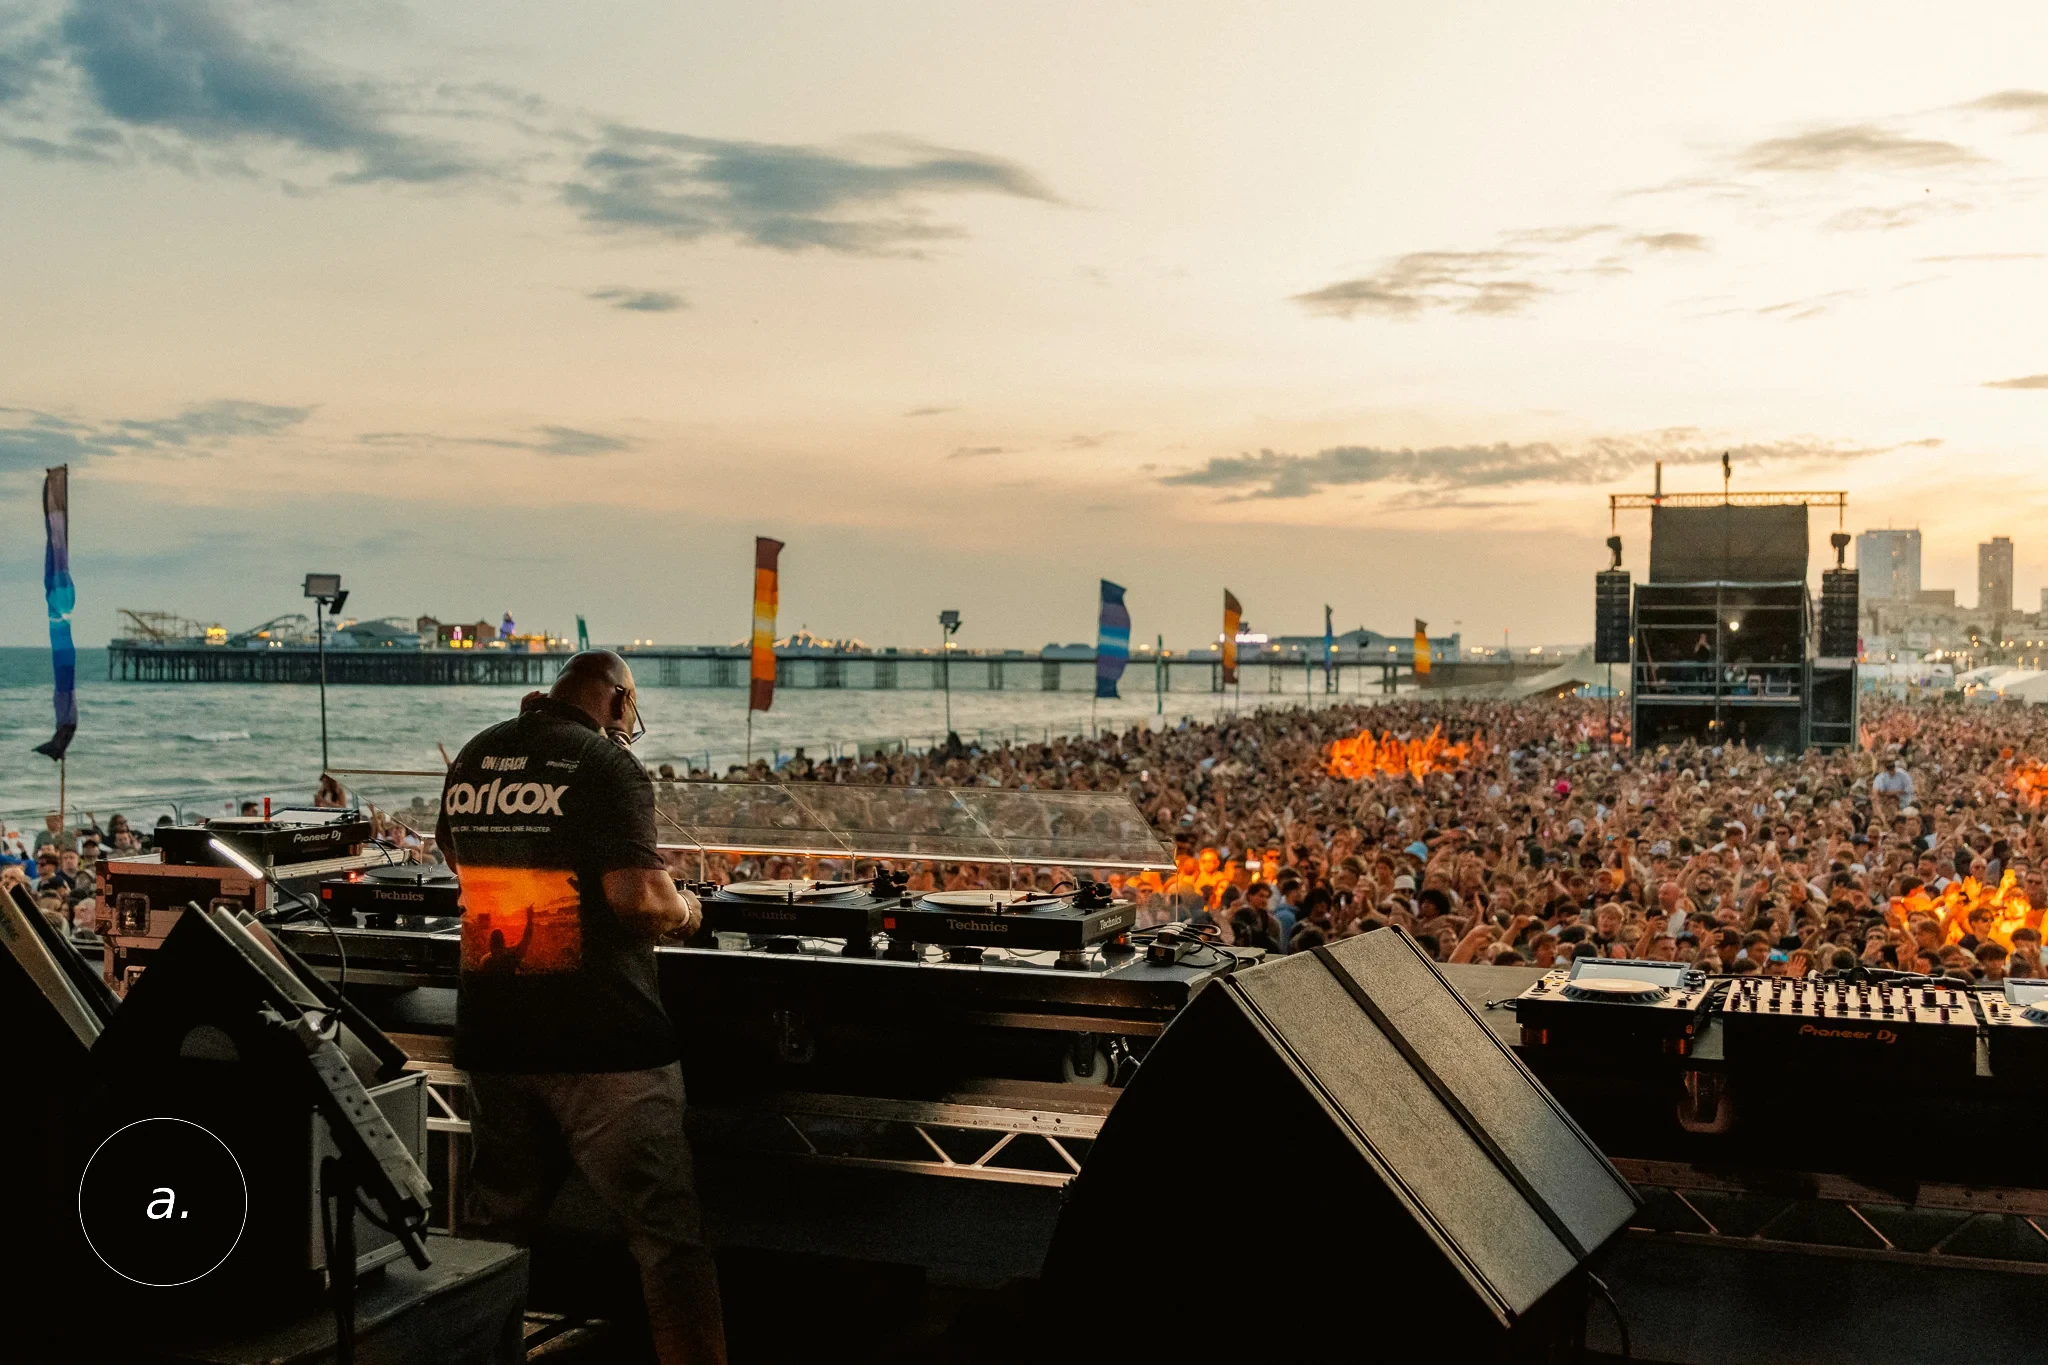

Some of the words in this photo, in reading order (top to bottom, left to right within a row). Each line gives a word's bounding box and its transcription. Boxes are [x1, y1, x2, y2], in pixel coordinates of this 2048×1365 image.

[481, 756, 497, 770] ON
[293, 832, 330, 843] Pioneer
[372, 889, 424, 901] Technics
[946, 918, 1009, 933] Technics
[1100, 915, 1122, 930] Technics
[1798, 1024, 1872, 1039] Pioneer
